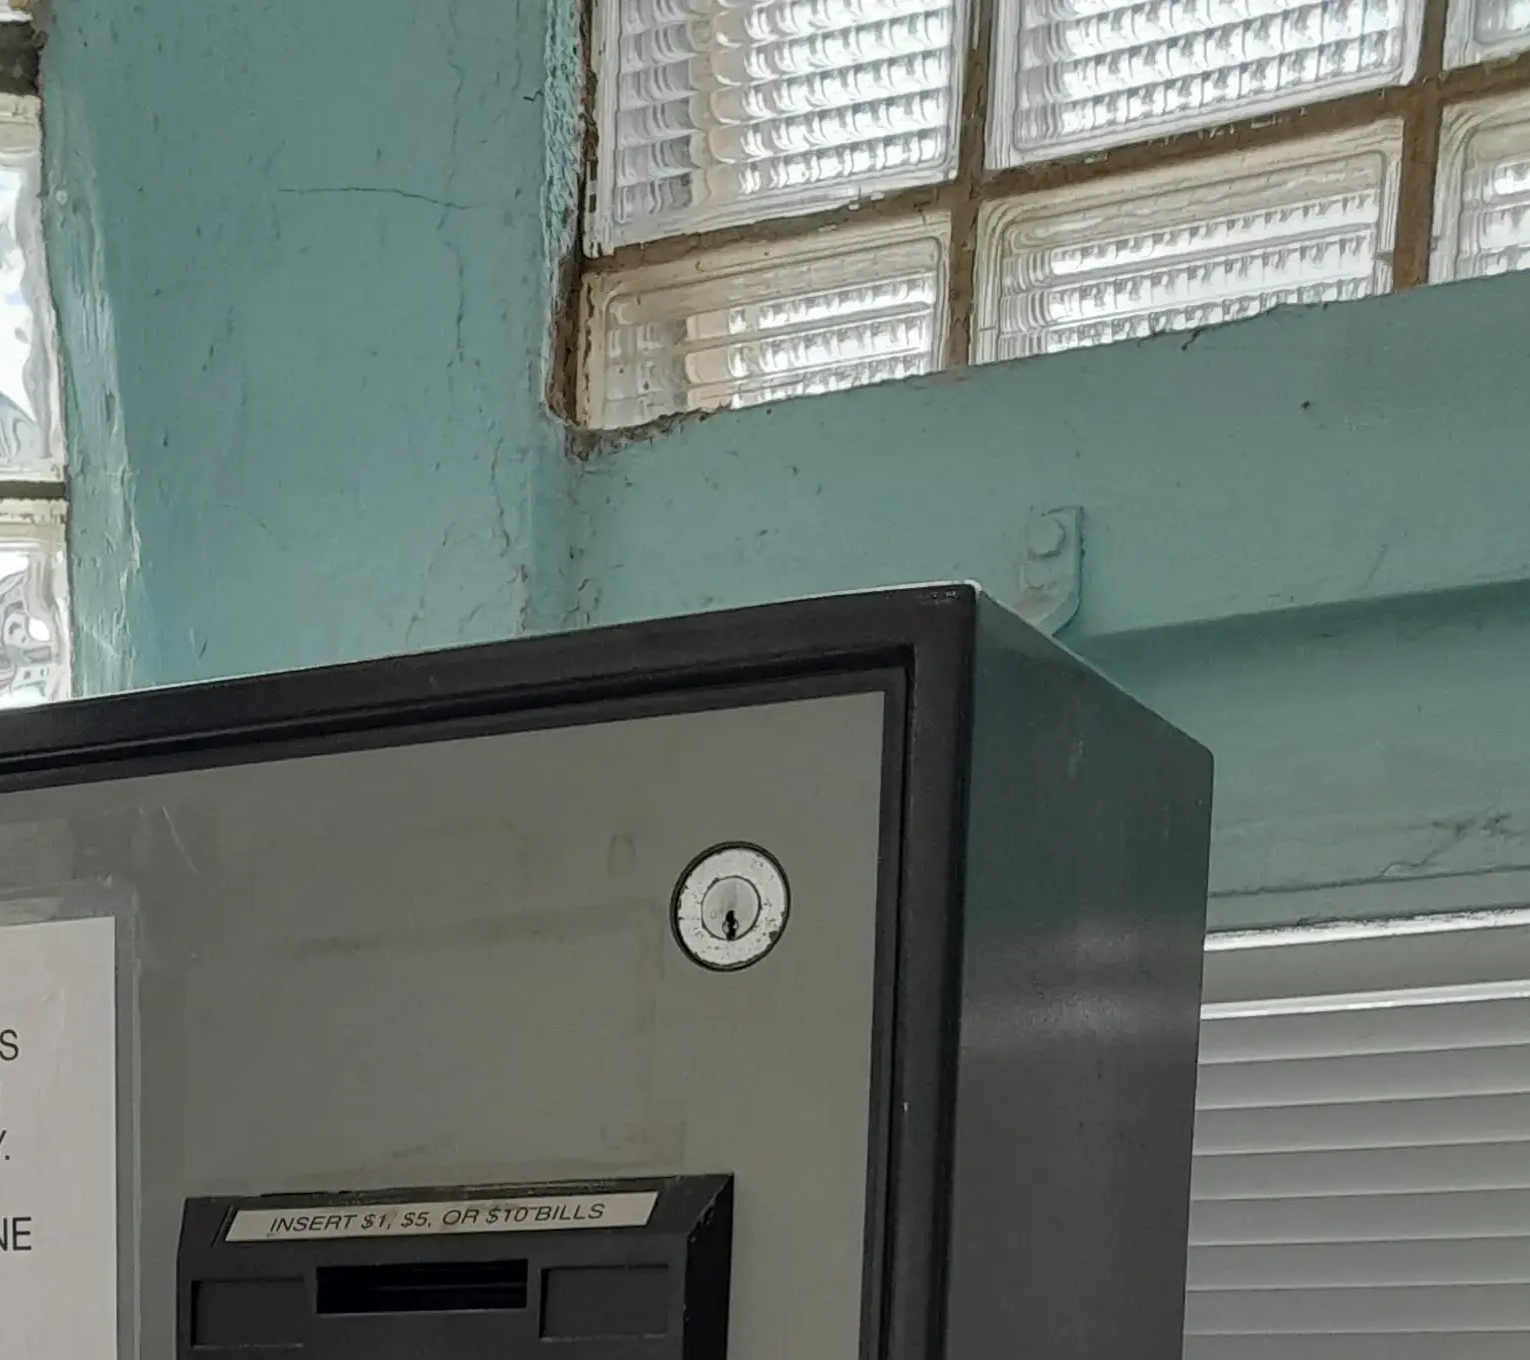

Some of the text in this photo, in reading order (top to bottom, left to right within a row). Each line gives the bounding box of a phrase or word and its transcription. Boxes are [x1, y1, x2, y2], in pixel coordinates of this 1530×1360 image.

[270, 1214, 356, 1232] INSERT
[360, 1213, 391, 1230] $1,
[442, 1209, 478, 1225] OR
[485, 1206, 529, 1224] $10
[535, 1203, 605, 1221] BILLS
